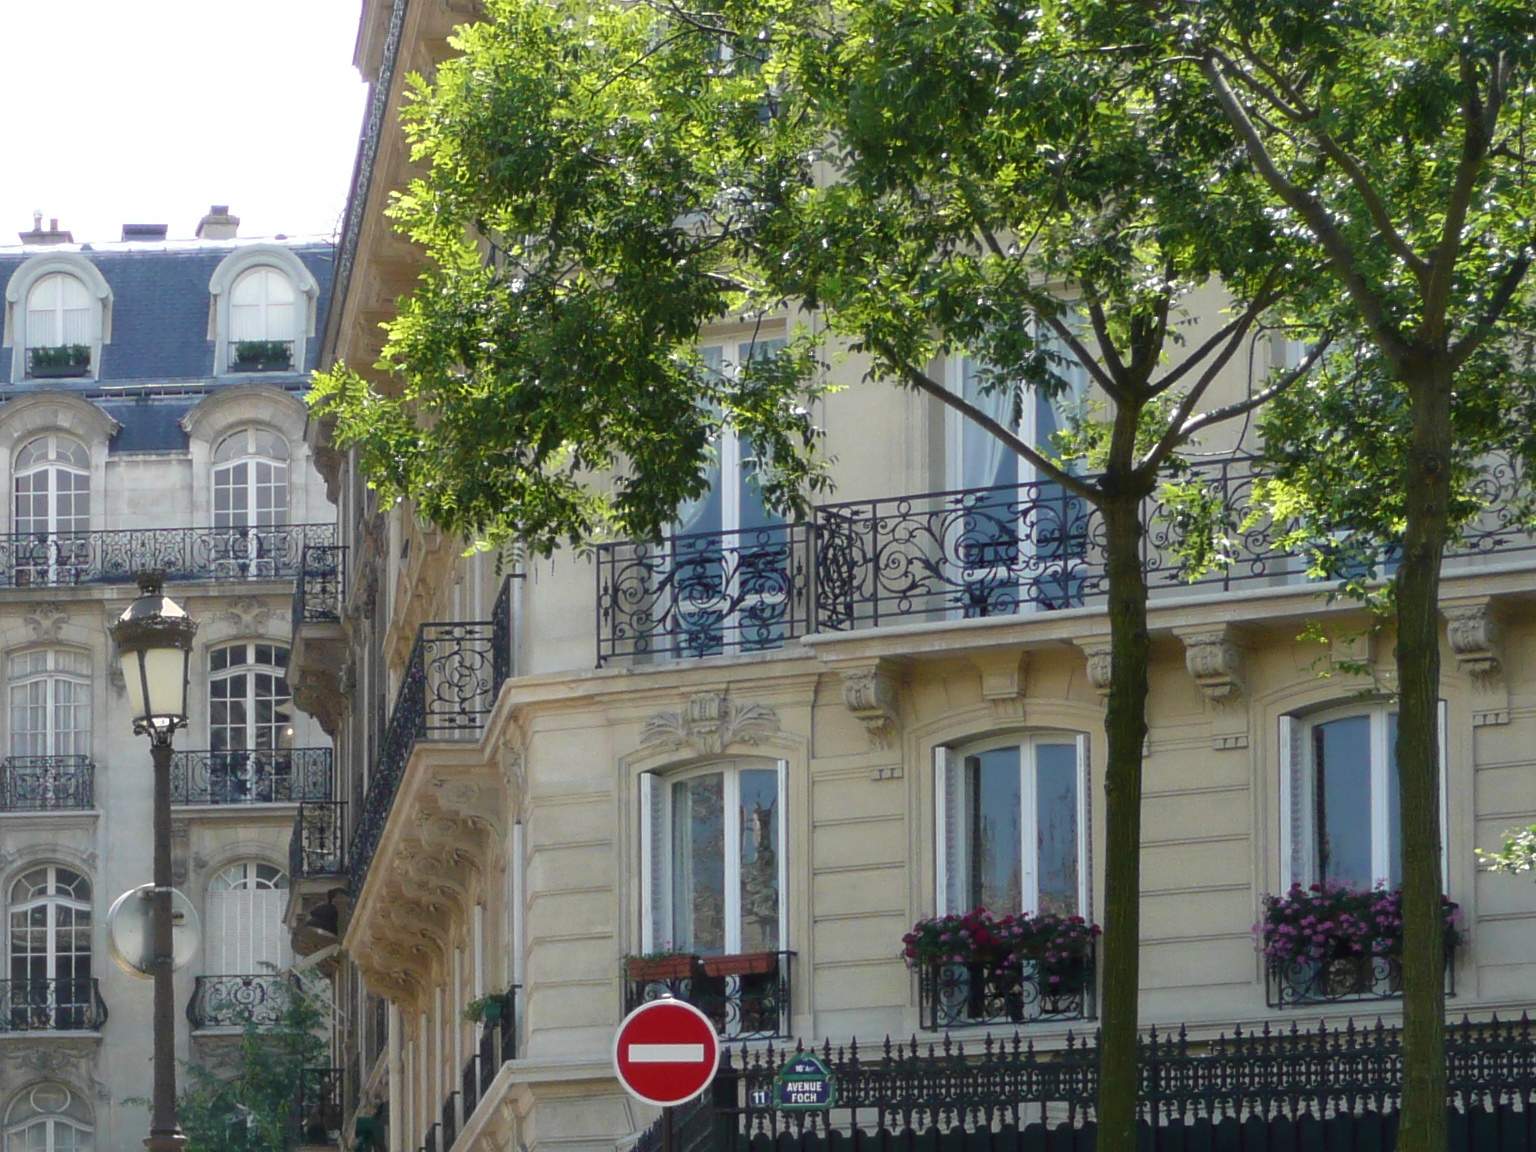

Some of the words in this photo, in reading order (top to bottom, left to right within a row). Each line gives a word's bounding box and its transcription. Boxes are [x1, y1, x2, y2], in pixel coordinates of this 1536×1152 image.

[787, 1081, 822, 1092] AVENUE
[752, 1091, 765, 1104] 11
[791, 1093, 817, 1103] FOCH
